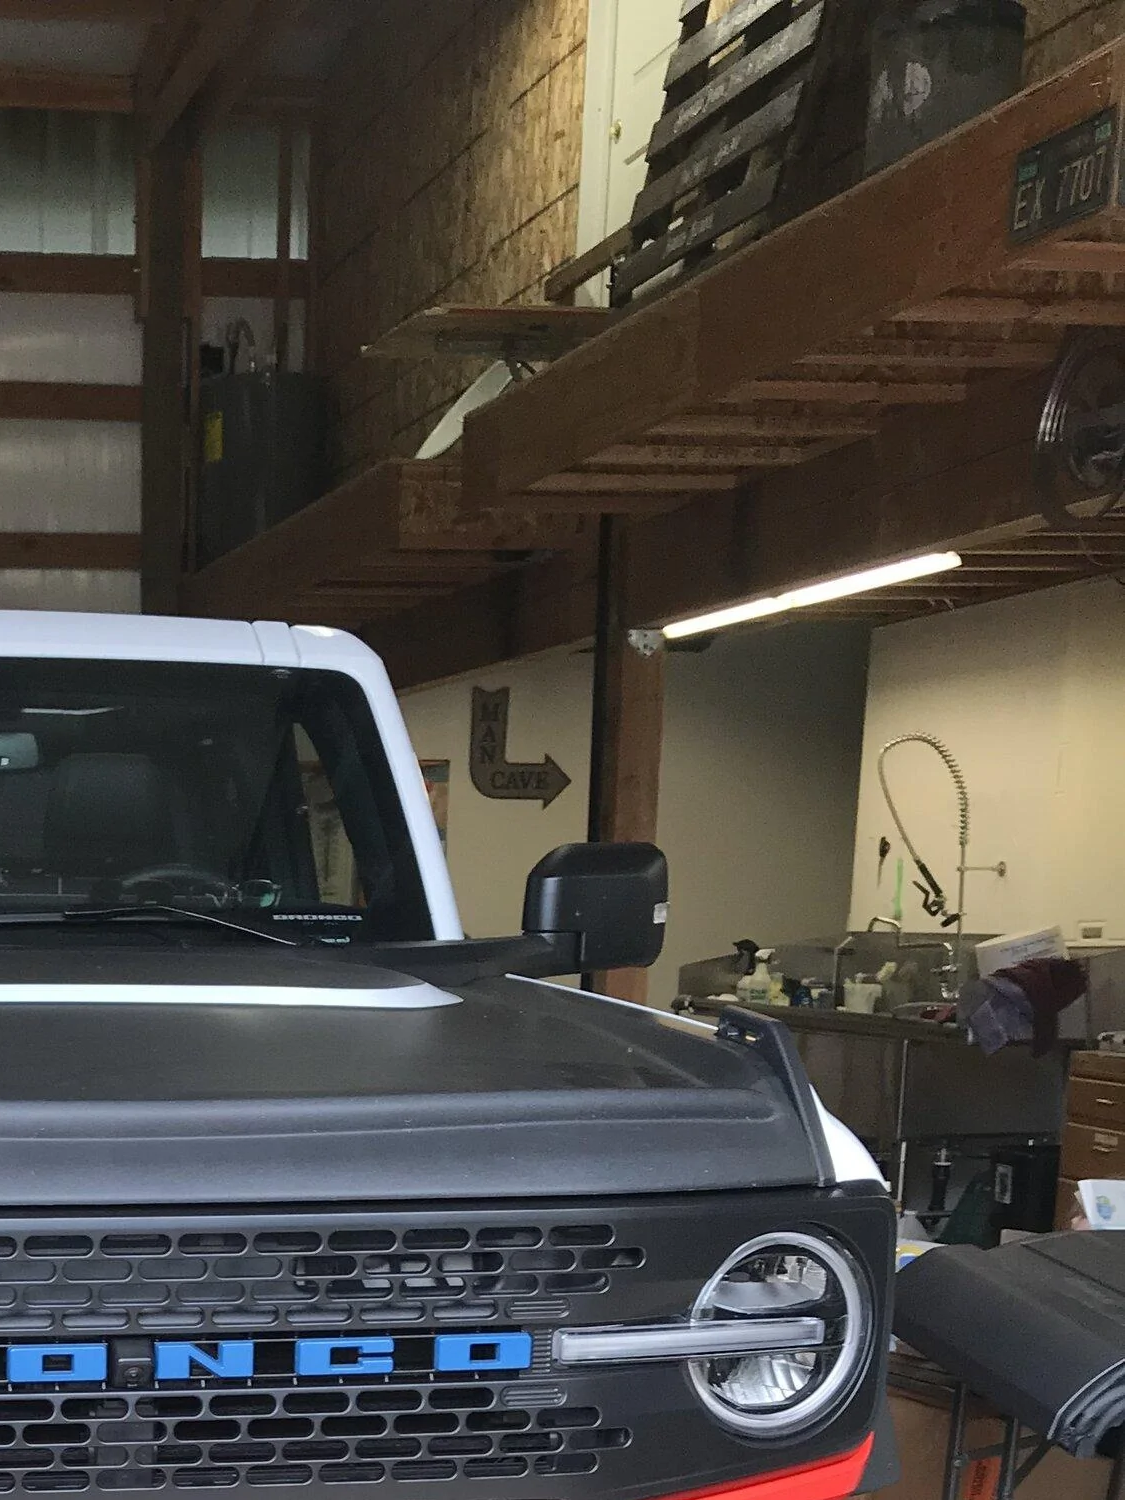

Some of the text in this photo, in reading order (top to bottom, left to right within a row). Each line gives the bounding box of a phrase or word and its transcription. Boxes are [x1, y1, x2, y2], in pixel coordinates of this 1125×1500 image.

[1013, 177, 1047, 231] EX
[479, 702, 501, 764] MAN
[490, 770, 551, 790] CAVE
